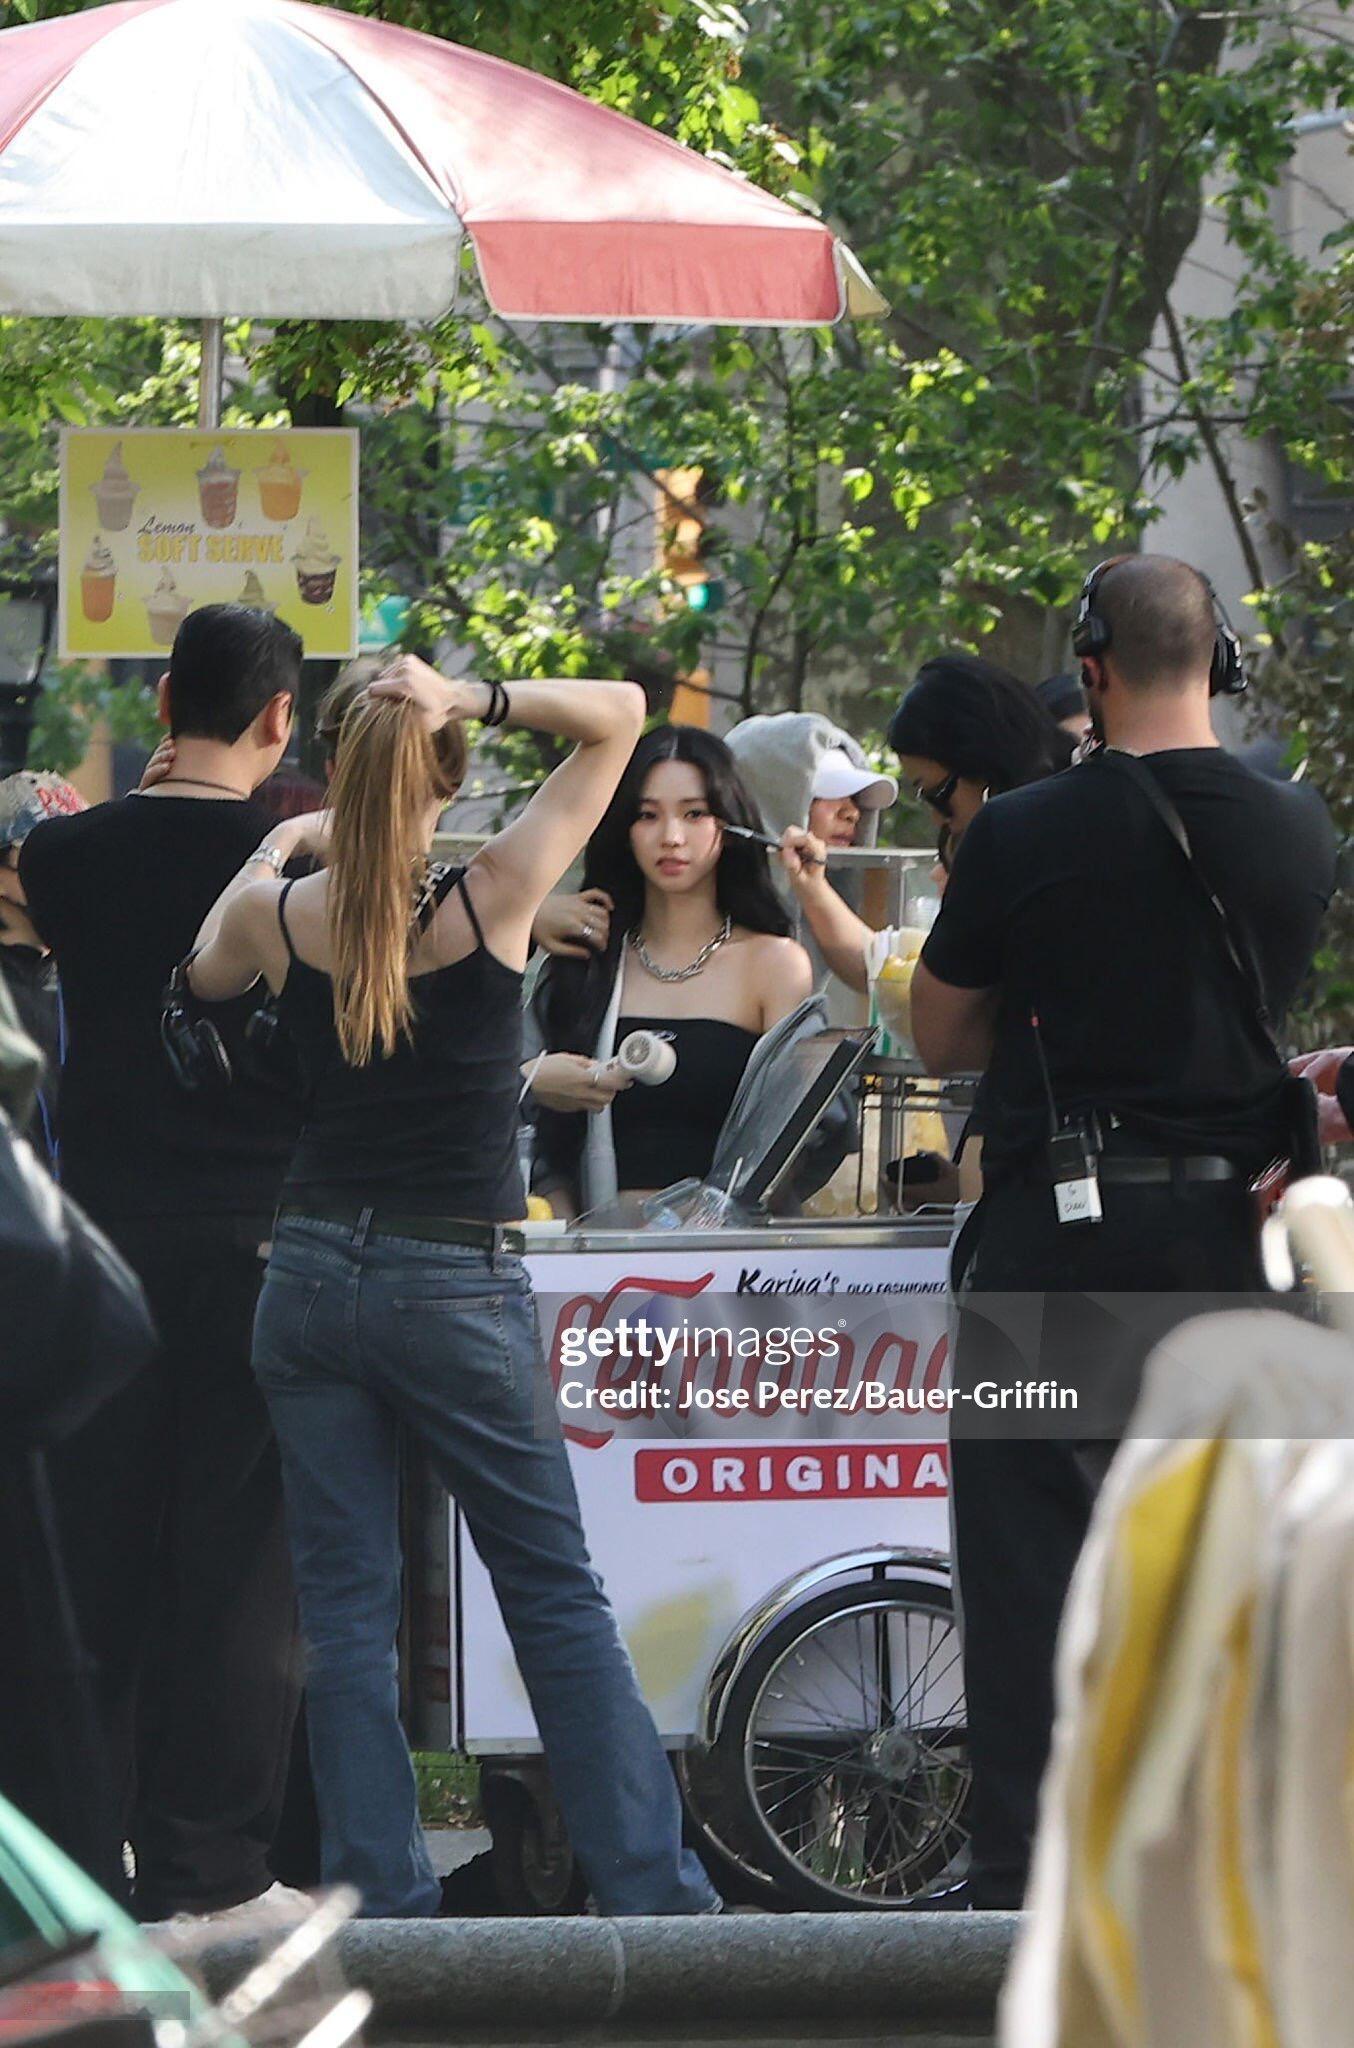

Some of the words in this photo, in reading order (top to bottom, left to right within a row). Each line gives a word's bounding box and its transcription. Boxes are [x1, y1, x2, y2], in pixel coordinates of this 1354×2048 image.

[138, 515, 195, 535] Lemon
[138, 534, 202, 563] SOFT
[206, 534, 284, 563] SERVE
[737, 1268, 840, 1297] Karina's
[847, 1281, 873, 1296] OLD
